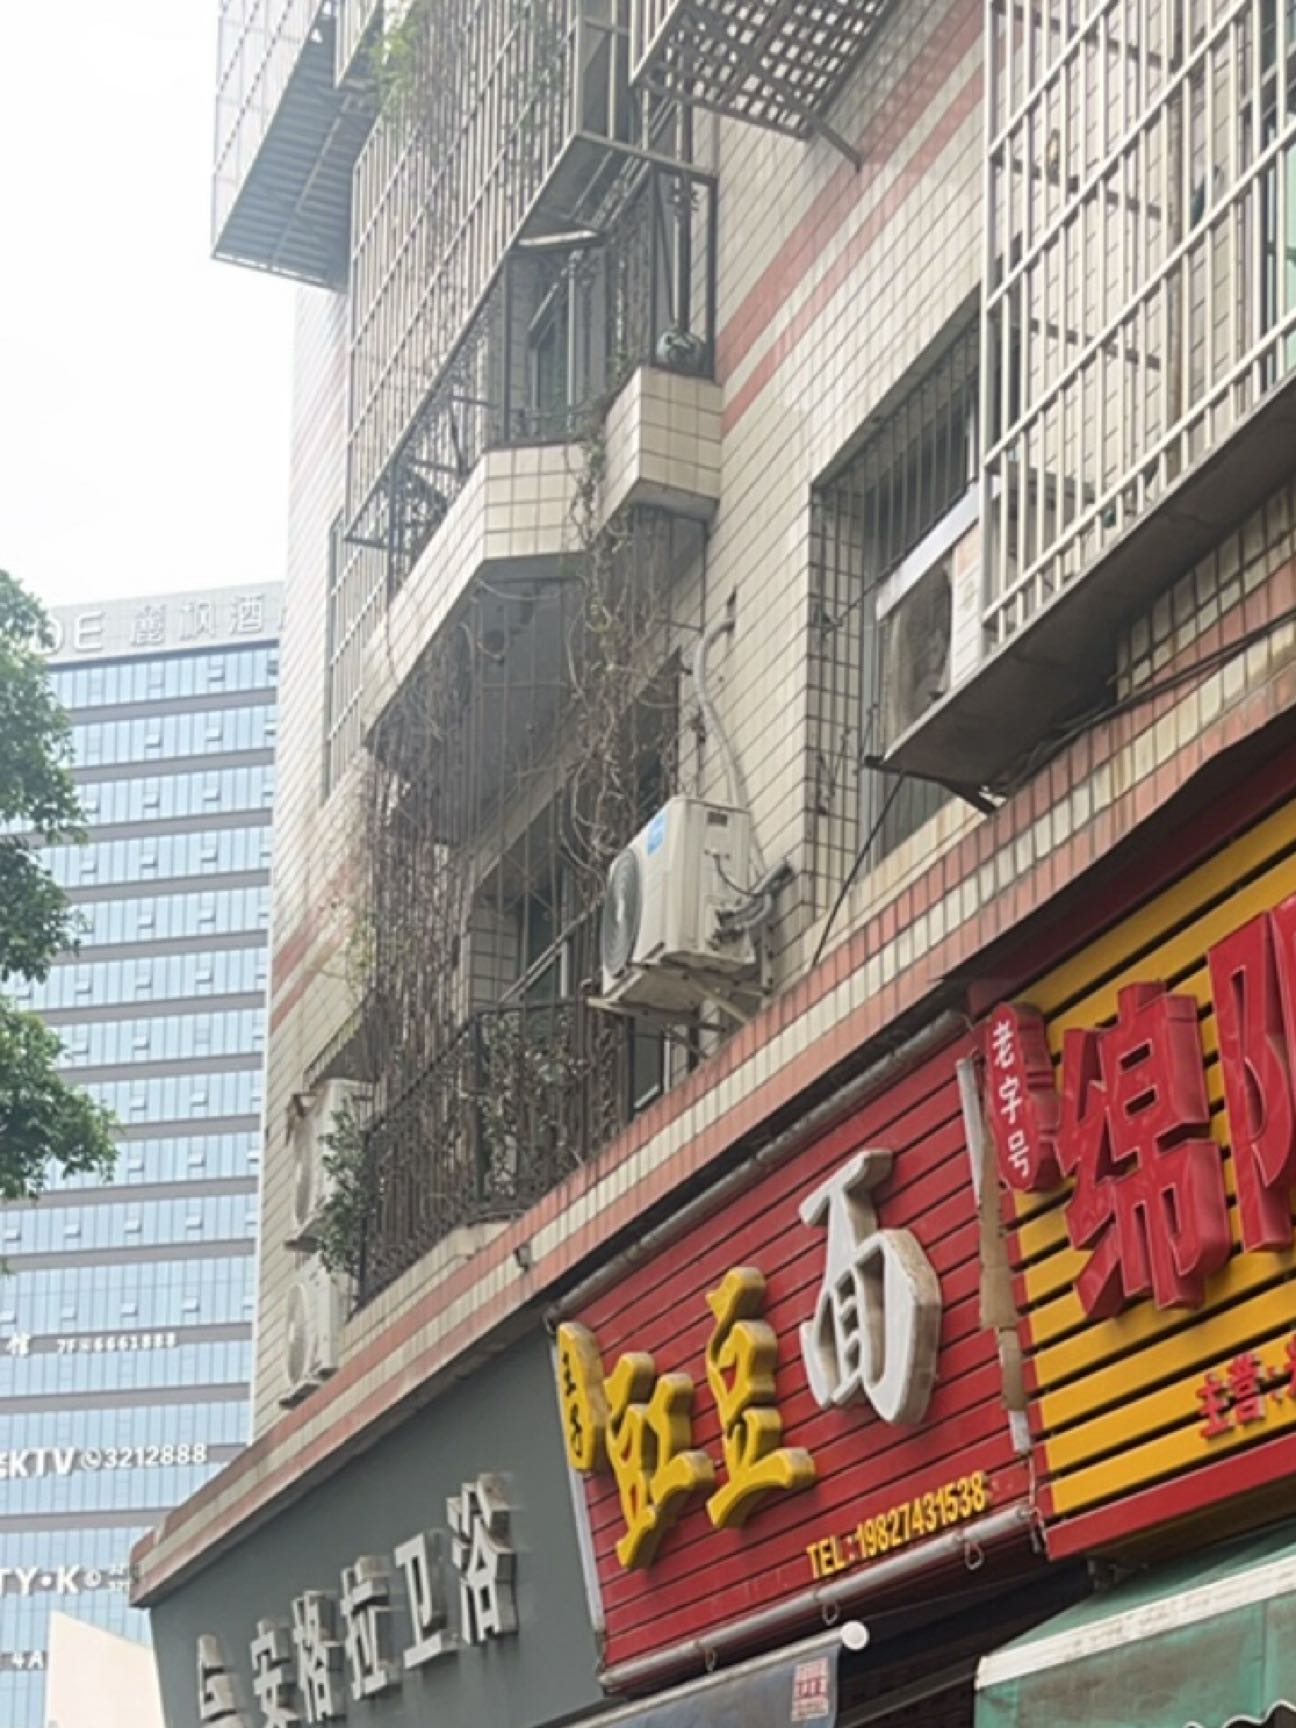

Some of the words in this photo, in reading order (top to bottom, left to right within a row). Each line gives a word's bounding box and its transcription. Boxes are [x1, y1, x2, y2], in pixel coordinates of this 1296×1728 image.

[992, 1020, 1030, 1178] 老字号
[0, 1446, 75, 1479] KTV
[103, 1442, 209, 1470] 3212888
